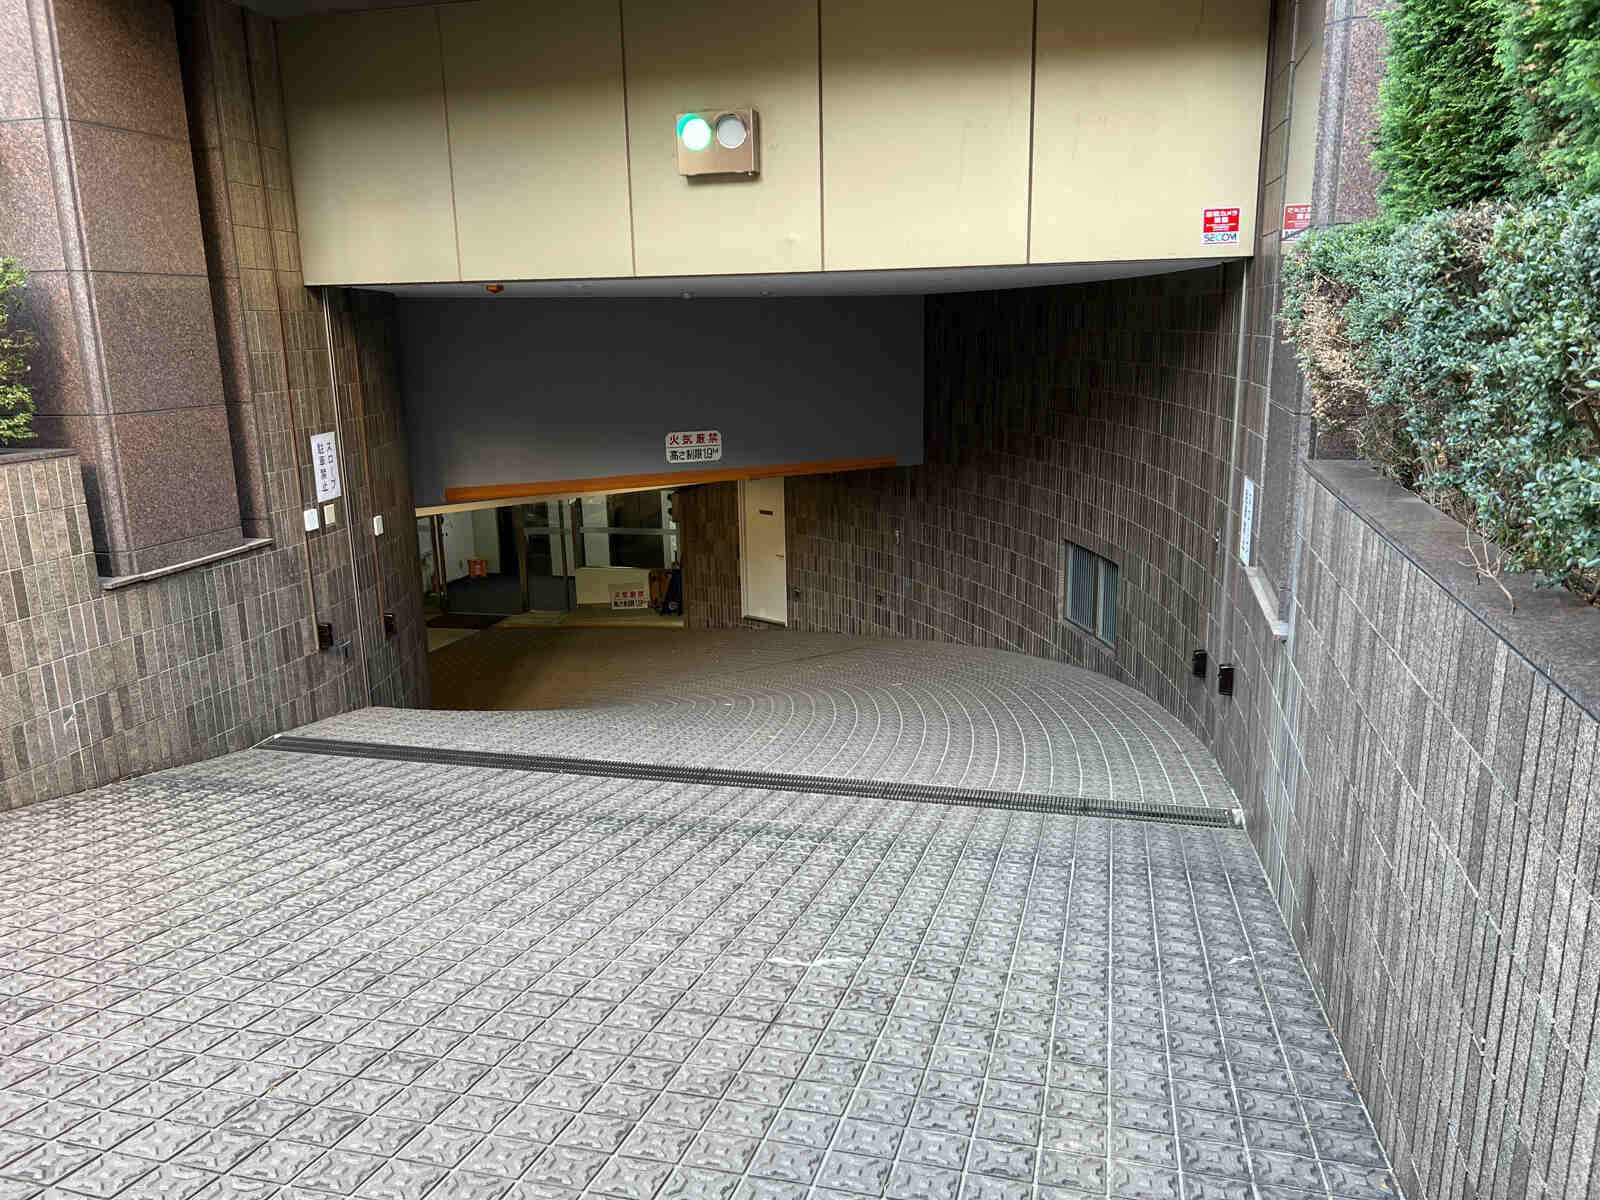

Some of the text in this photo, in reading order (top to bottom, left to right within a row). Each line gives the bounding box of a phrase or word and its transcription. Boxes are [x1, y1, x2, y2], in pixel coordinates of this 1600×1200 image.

[1203, 232, 1237, 242] SECOM
[669, 432, 719, 445] 火気厳禁
